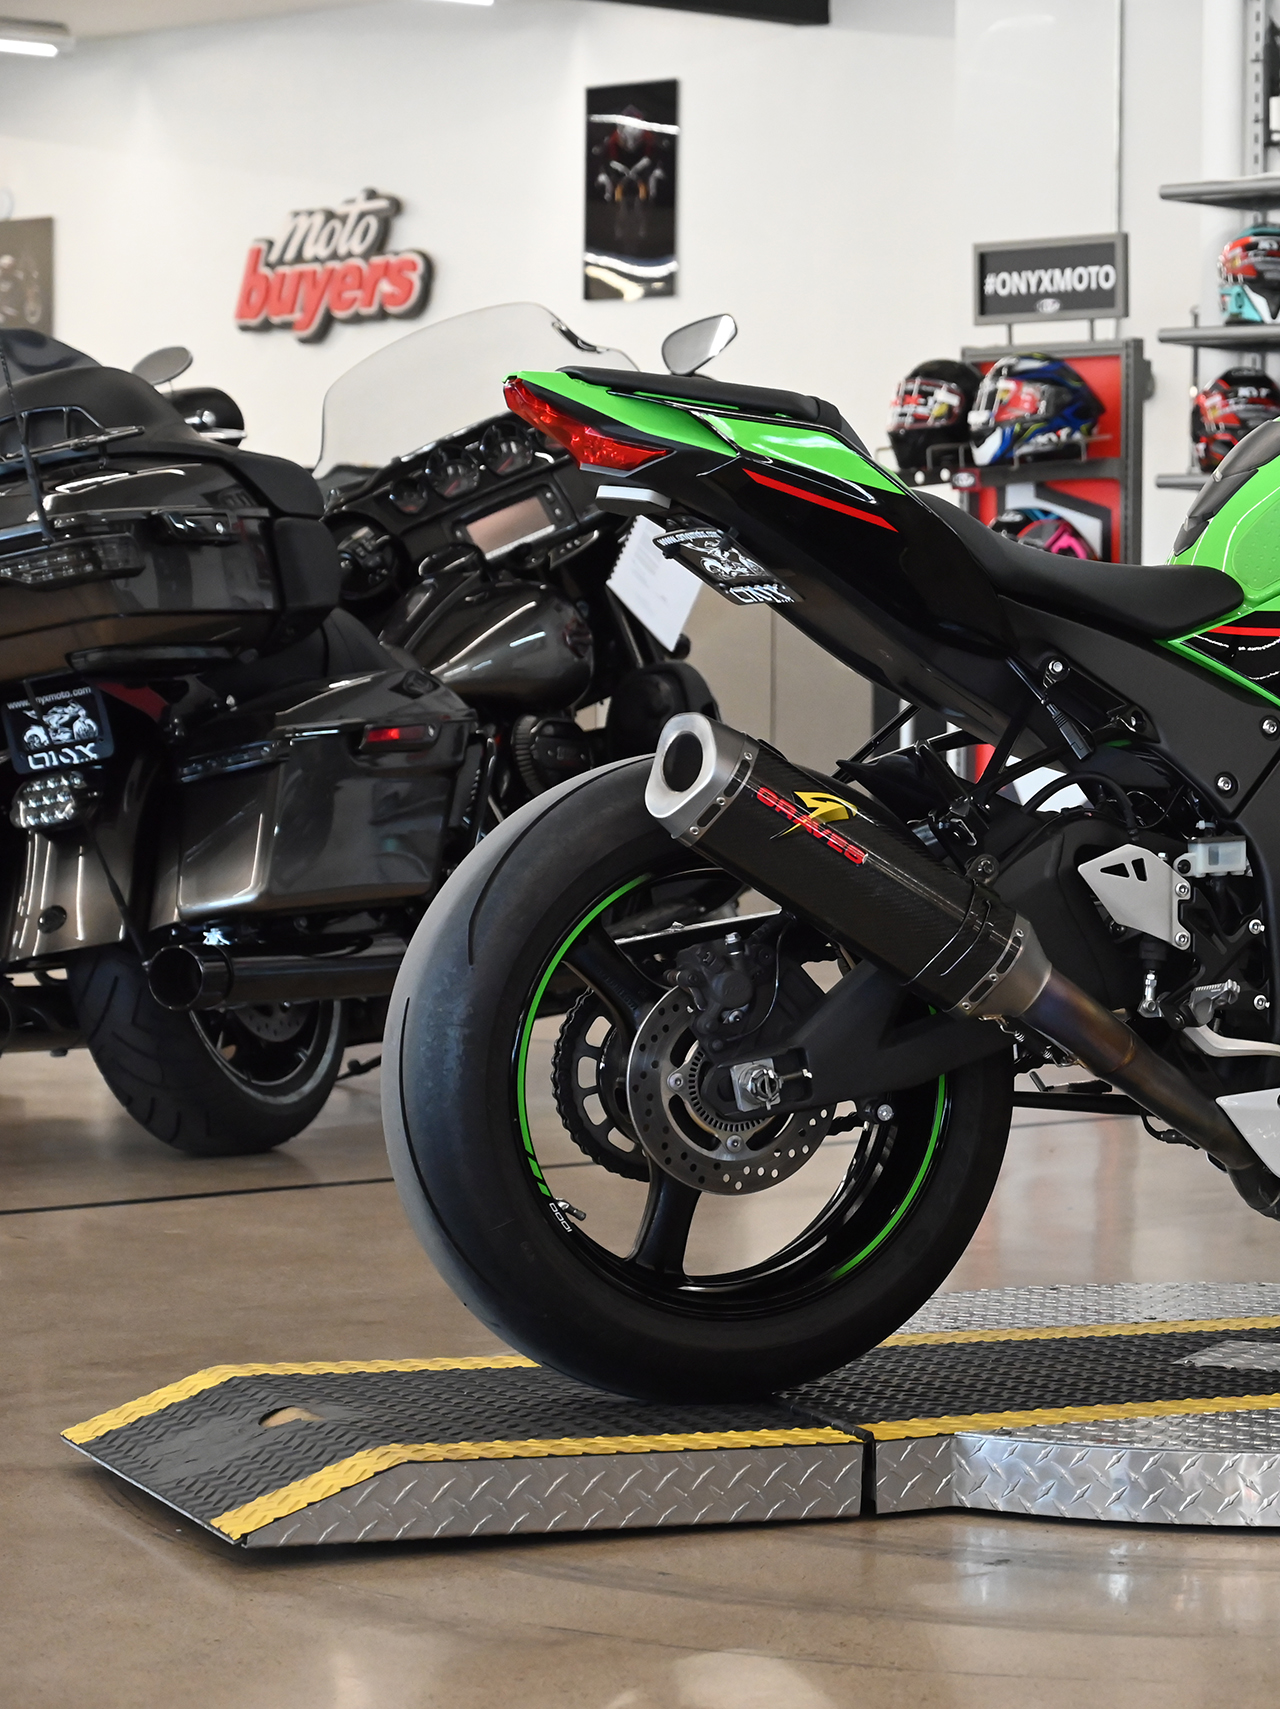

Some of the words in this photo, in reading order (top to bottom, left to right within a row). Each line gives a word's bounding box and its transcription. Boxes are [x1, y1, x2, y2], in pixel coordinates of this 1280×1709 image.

[235, 245, 420, 333] buyers
[984, 264, 1117, 297] #ONYXMOTO
[7, 686, 92, 710] www.nyxmoto.com
[756, 787, 869, 865] GRAVES
